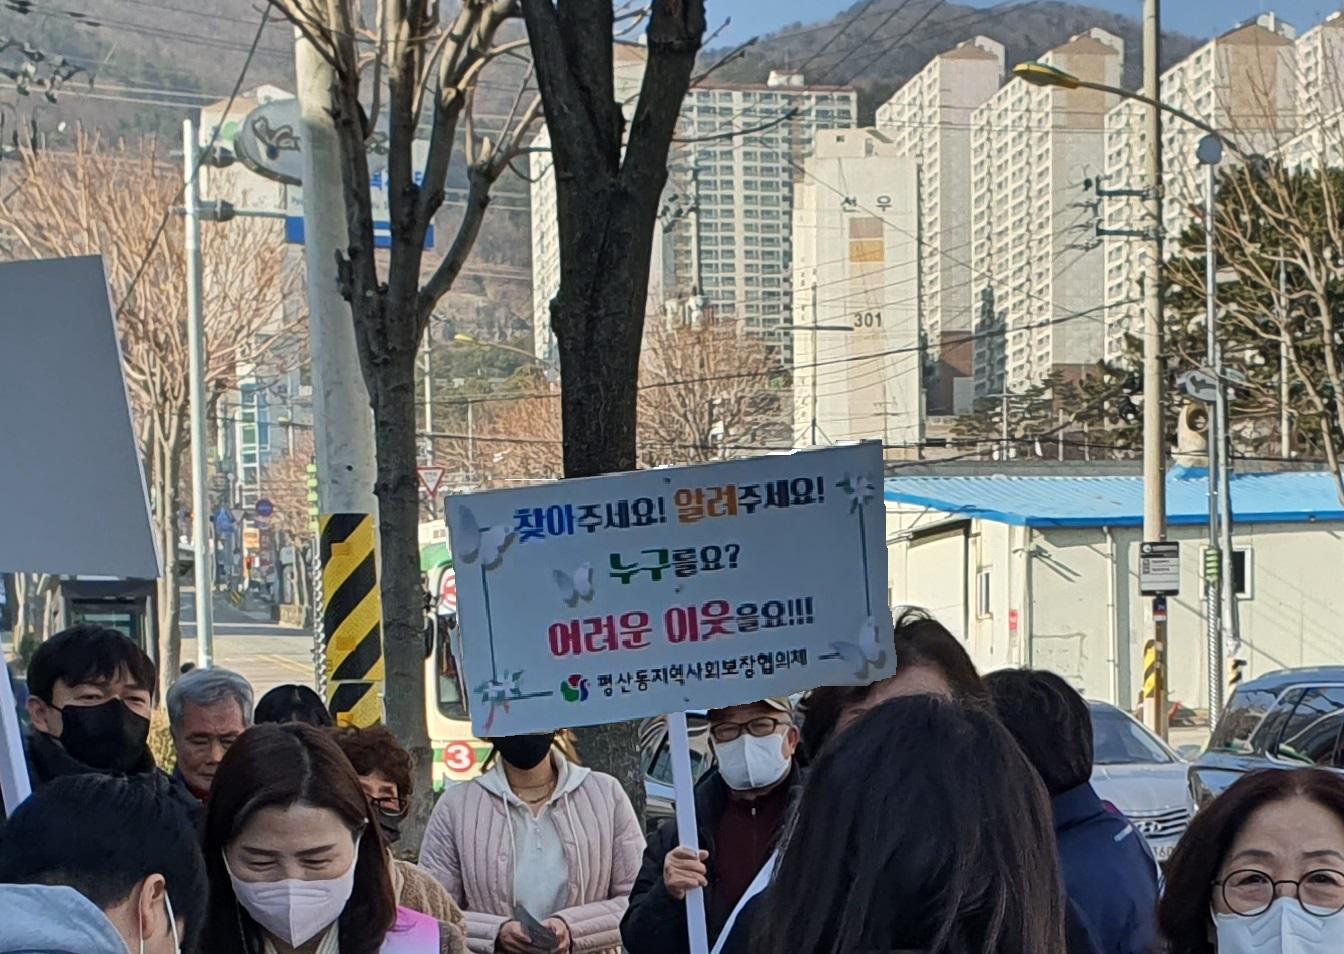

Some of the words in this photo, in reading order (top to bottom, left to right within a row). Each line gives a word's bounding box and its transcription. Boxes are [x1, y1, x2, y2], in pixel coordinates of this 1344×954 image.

[853, 311, 883, 328] 301
[513, 494, 666, 543] 찾아주세요!
[674, 475, 825, 524] 알려주세요!
[609, 543, 741, 584] 누구를요?
[548, 609, 653, 657] 어려운
[664, 596, 815, 642] 이웃을요!!!
[445, 744, 472, 769] 3
